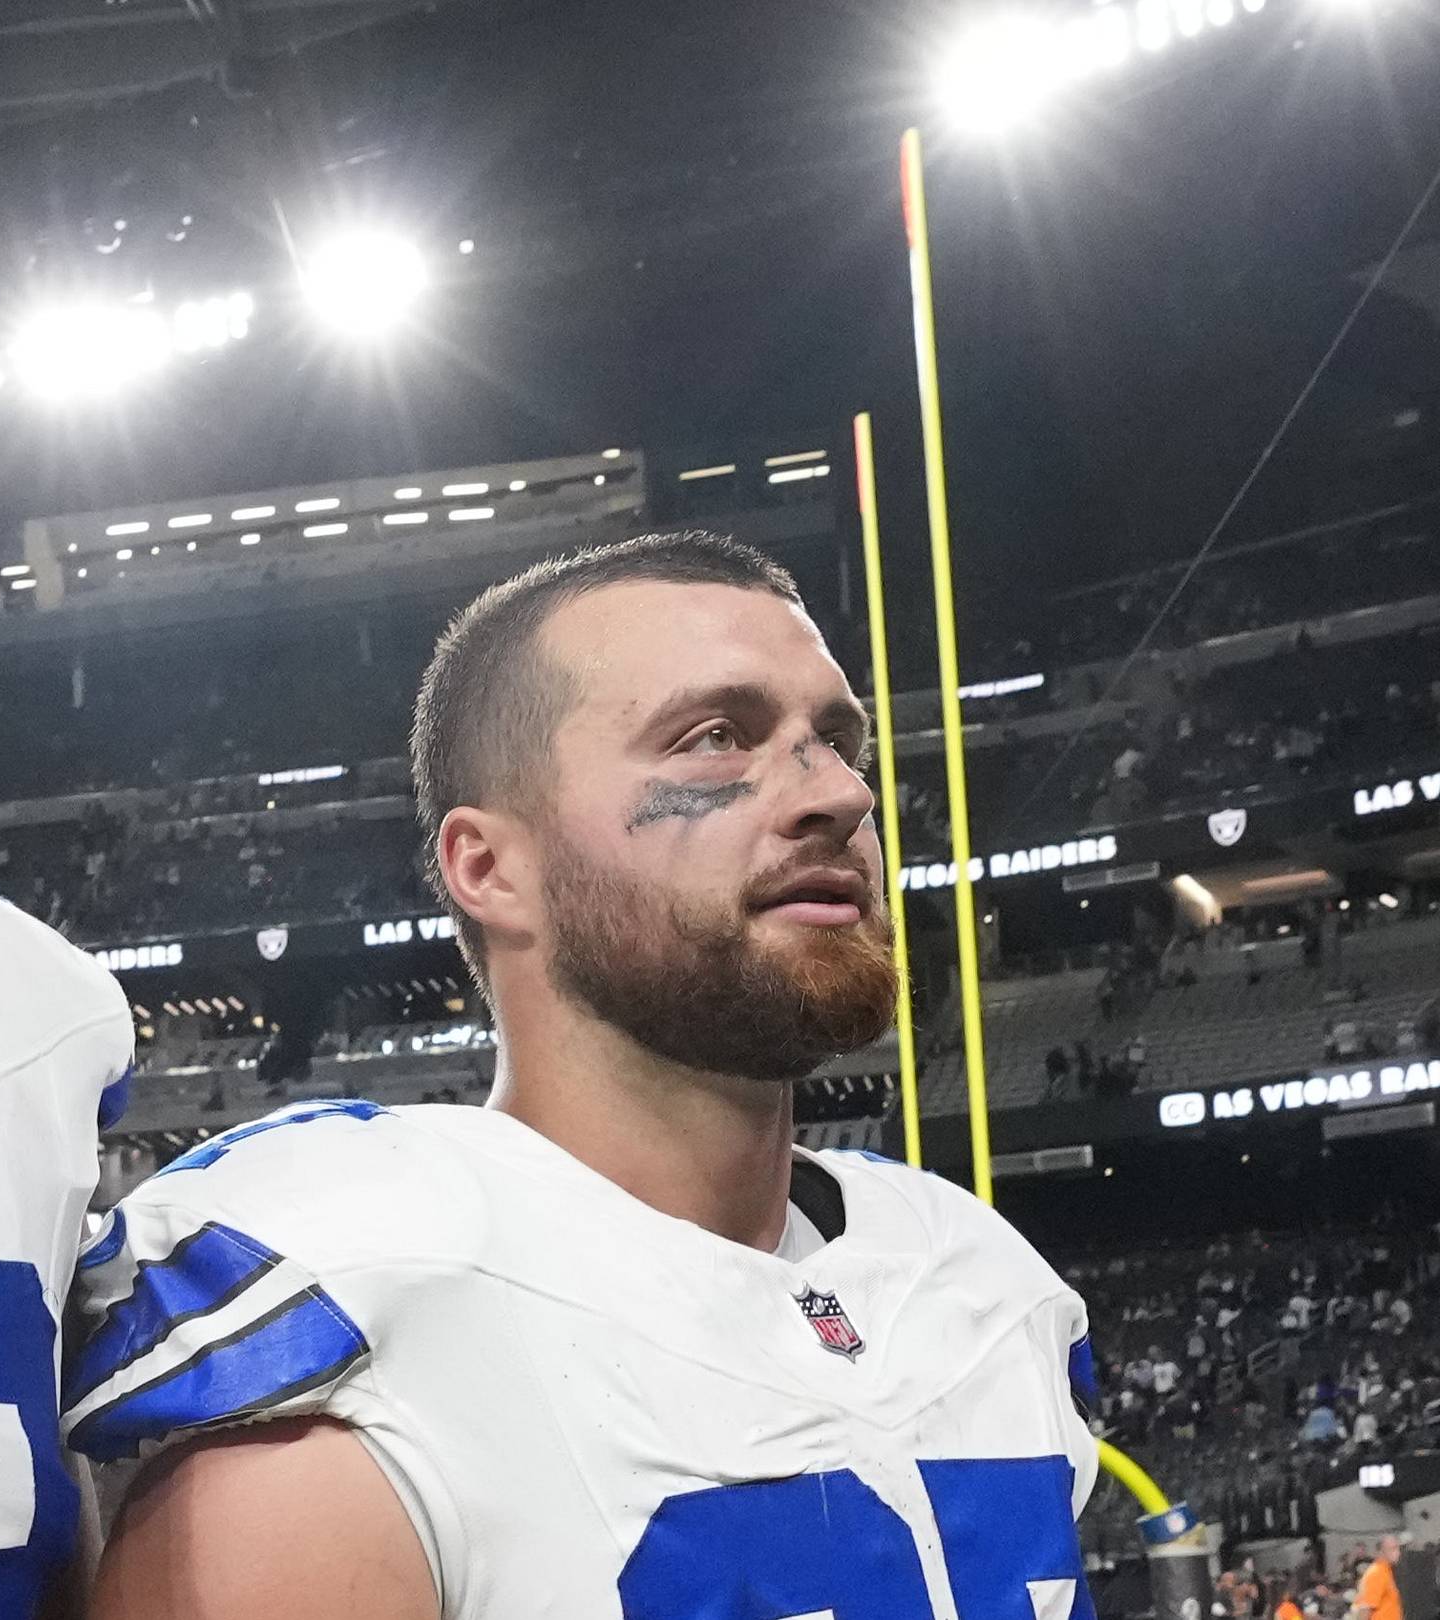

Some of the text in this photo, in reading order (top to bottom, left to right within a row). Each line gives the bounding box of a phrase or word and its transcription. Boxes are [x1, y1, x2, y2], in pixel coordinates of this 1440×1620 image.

[1354, 780, 1414, 815] LAS
[990, 835, 1117, 878] RAIDERS
[364, 920, 412, 945] LAS
[1260, 1071, 1372, 1112] VEGAS
[811, 1317, 857, 1347] NFL
